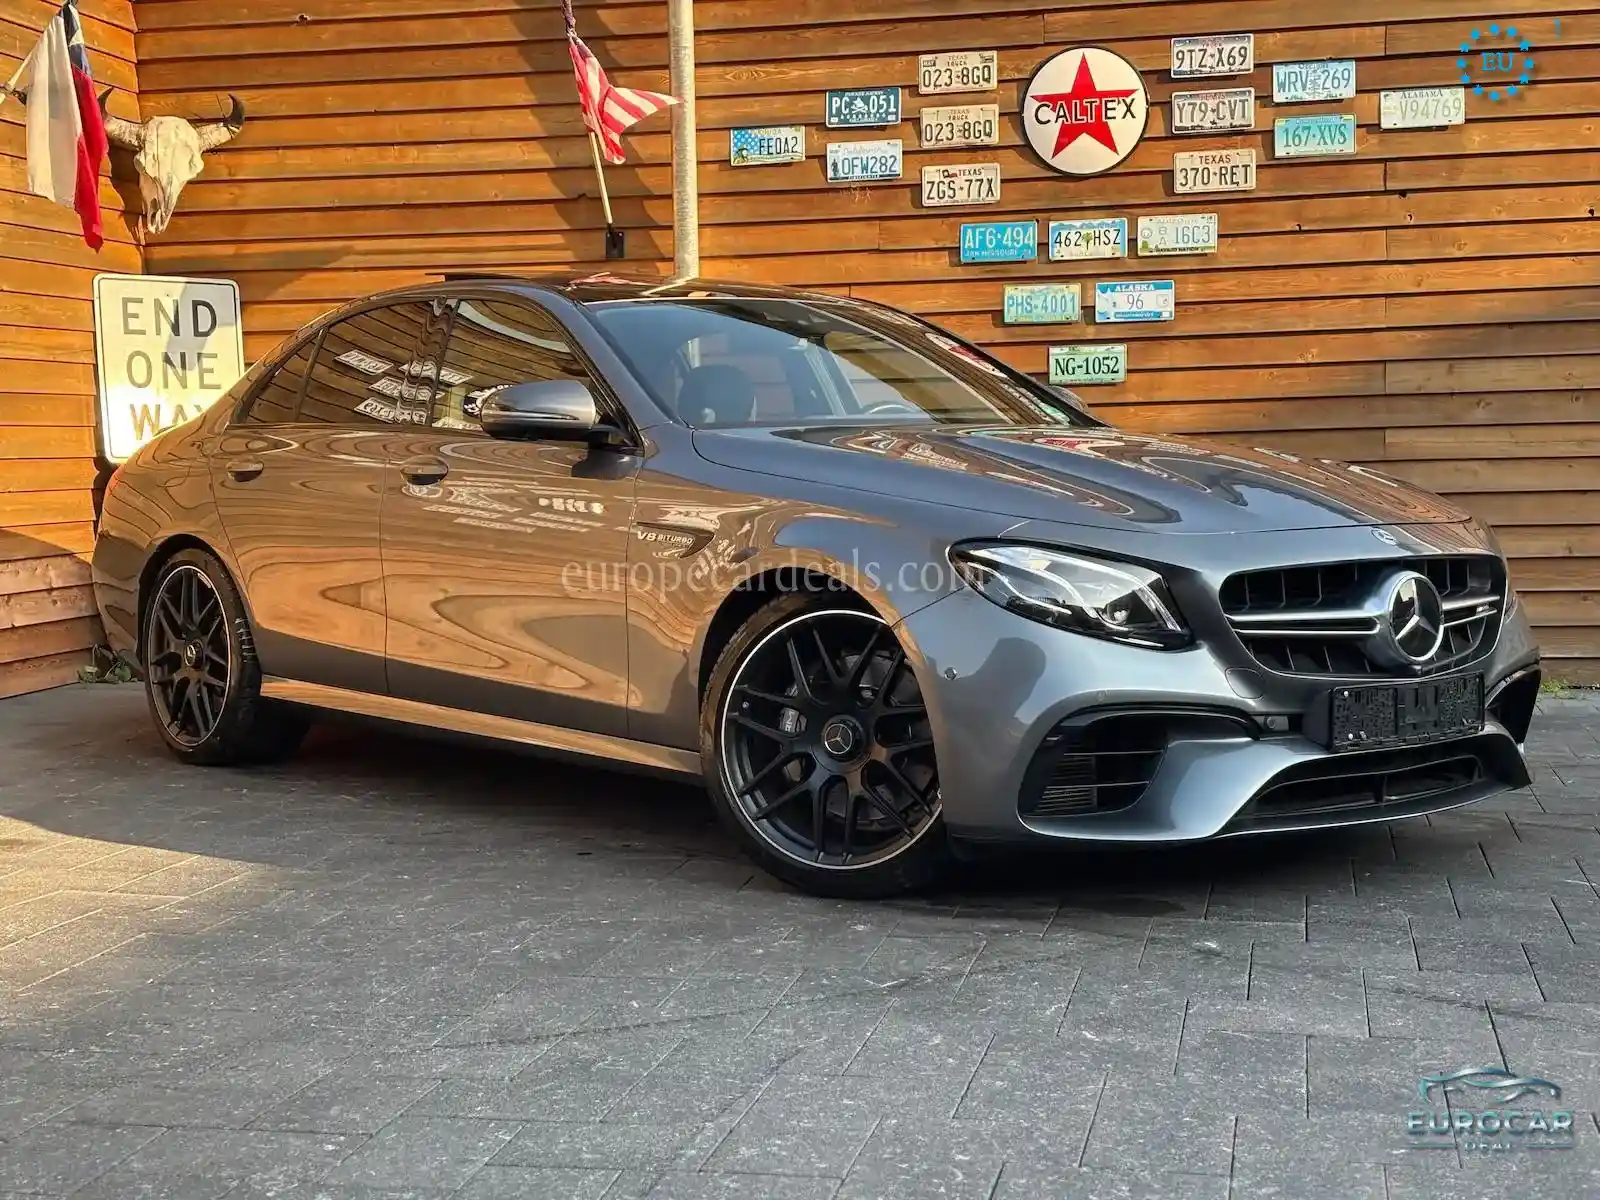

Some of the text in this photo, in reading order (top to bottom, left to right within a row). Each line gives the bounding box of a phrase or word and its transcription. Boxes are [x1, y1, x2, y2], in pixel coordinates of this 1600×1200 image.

[1321, 68, 1351, 90] 269
[1400, 89, 1443, 99] ALABAMA
[831, 96, 850, 115] PC
[1034, 97, 1136, 125] CALTEX
[1198, 153, 1231, 165] TEXAS
[957, 168, 982, 177] TEXAS
[1054, 228, 1121, 248] 462 HSZ
[1114, 283, 1155, 293] ALASKA
[1127, 293, 1144, 310] 96
[121, 296, 218, 338] END
[126, 350, 222, 390] ONE
[1054, 356, 1120, 376] NG-1052
[129, 403, 206, 441] WA
[636, 530, 657, 542] V8
[657, 534, 694, 545] BITURBO
